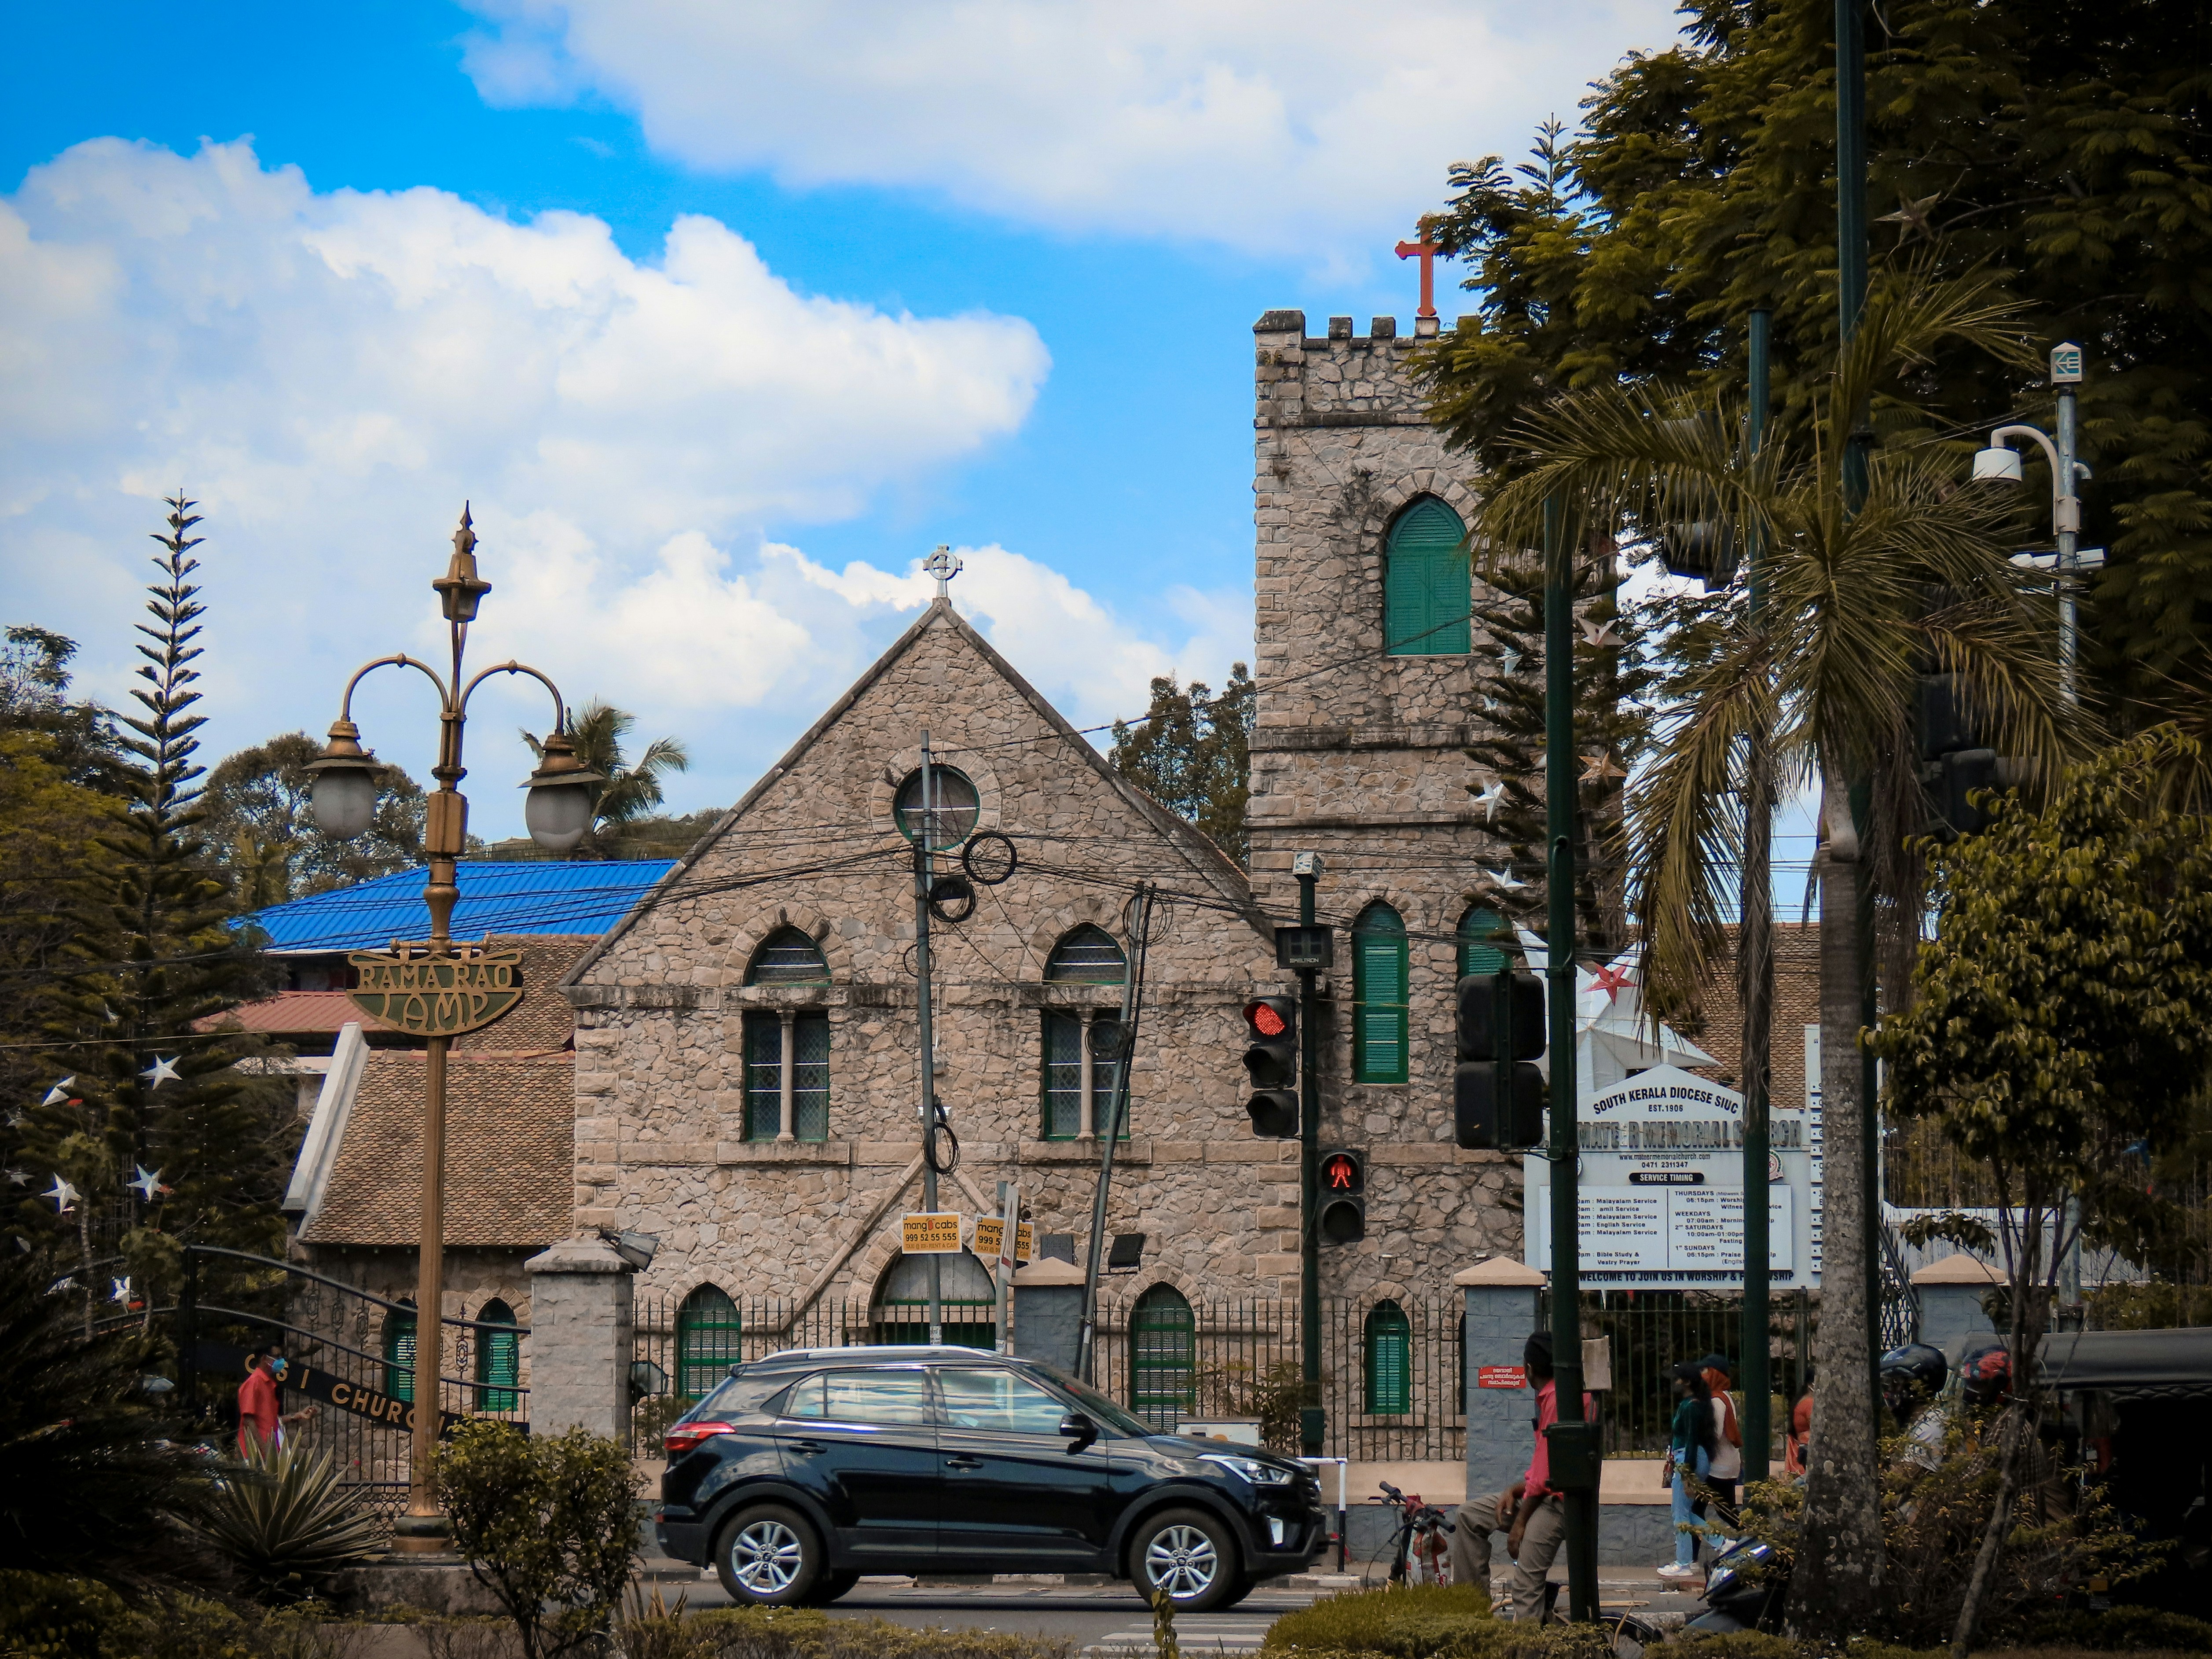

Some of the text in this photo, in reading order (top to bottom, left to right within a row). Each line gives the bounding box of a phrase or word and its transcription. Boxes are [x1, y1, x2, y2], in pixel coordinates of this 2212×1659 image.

[357, 964, 514, 989] RAMA RAO
[375, 992, 488, 1031] LAMP
[1593, 1087, 1738, 1115] SOUTH KERALA DIOCESE SIUC
[1643, 1121, 1730, 1148] MEMORIAL
[1733, 1120, 1801, 1147] CRCH
[935, 1219, 957, 1229] cabs
[1018, 1228, 1031, 1238] abs
[979, 1235, 993, 1244] 999
[1580, 1272, 1622, 1281] WELCOME
[1625, 1272, 1635, 1281] TO
[1638, 1272, 1658, 1281] JOIN
[1661, 1272, 1672, 1281] US
[1675, 1272, 1684, 1281] IN
[1687, 1272, 1728, 1281] WORSHIP
[1731, 1272, 1737, 1281] &
[301, 1369, 309, 1389] I
